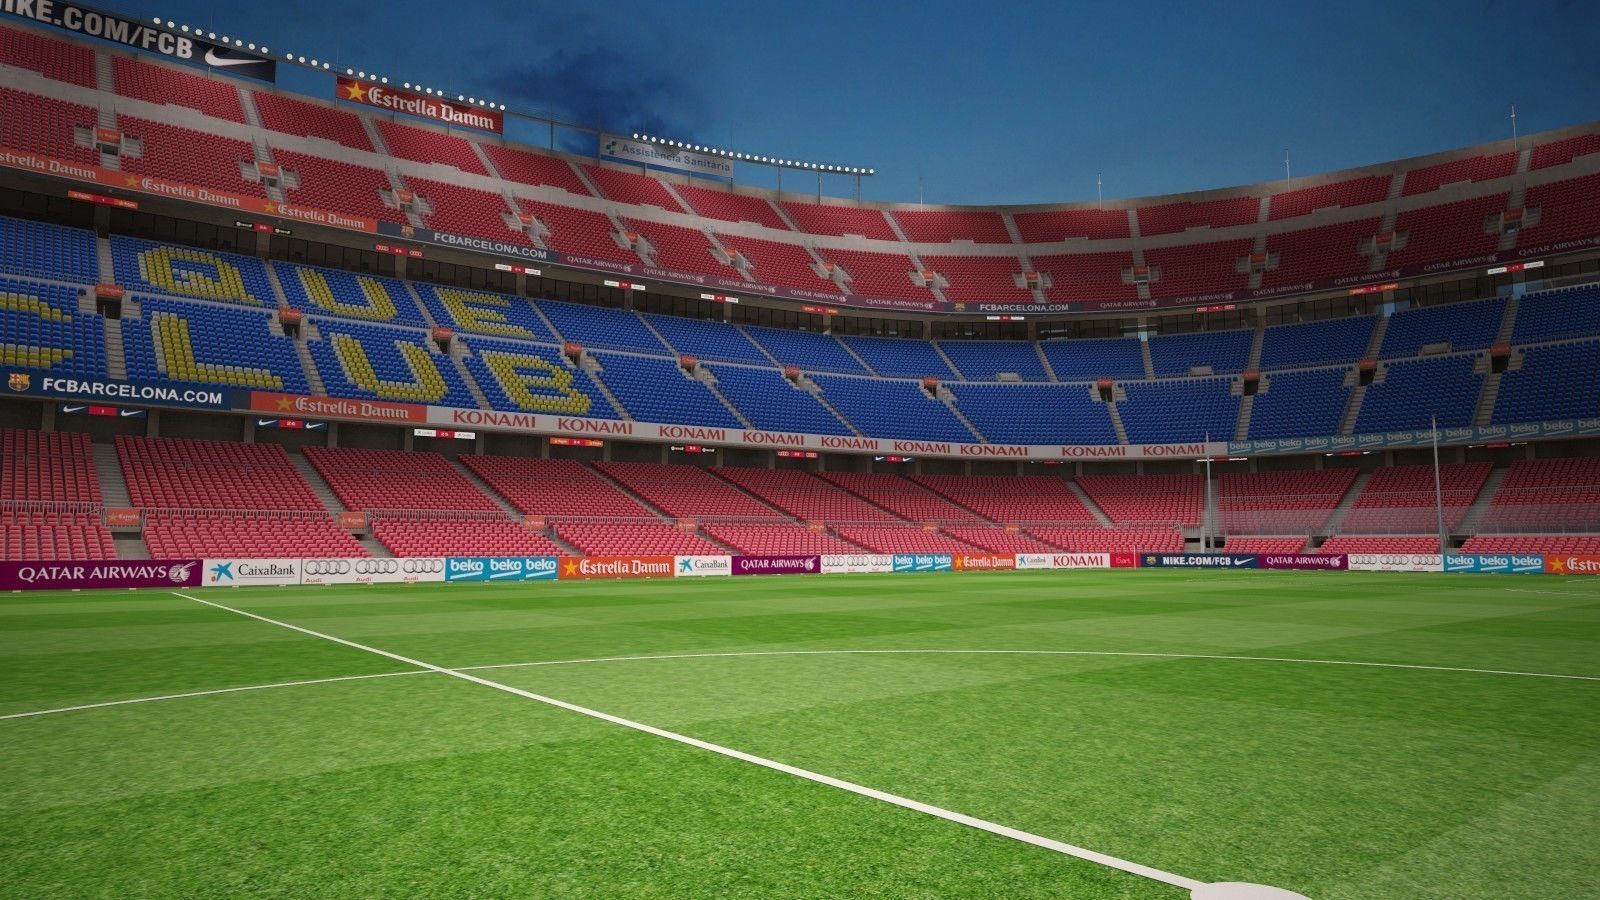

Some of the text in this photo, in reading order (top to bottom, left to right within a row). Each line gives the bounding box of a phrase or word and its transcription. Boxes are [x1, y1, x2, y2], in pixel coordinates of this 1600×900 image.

[0, 0, 193, 59] IKE.COM/FCB
[368, 86, 494, 130] Estrella Damm
[48, 159, 96, 180] Damm
[141, 177, 240, 207] Estrella Damm
[278, 204, 365, 229] Estrella Damm
[434, 232, 547, 260] FCBARCELONA.COM
[1519, 245, 1550, 257] QATAR
[567, 255, 592, 265] QATAR
[1424, 261, 1450, 272] QATAR
[644, 268, 666, 277] QATAR
[718, 279, 740, 288] QATAR
[1334, 276, 1358, 285] QATAR
[790, 289, 812, 297] QATAR
[1252, 287, 1275, 297] QATAR
[866, 298, 892, 306] QATAR
[1176, 296, 1196, 304] QATAR
[980, 304, 1069, 312] FCBARCELONA.COM
[42, 378, 223, 405] FCBARCELONA.COM
[295, 398, 408, 419] Estrella Damm
[454, 410, 536, 428] KONAMI
[558, 418, 633, 435] KONAMI
[1478, 425, 1506, 435] beko
[1510, 423, 1539, 433] beko
[1543, 421, 1574, 431] beko
[659, 425, 726, 441] KONAMI
[1386, 432, 1412, 441] beko
[1446, 428, 1472, 438] beko
[743, 431, 804, 446] KONAMI
[821, 437, 878, 450] KONAMI
[1280, 438, 1302, 448] beko
[1304, 438, 1328, 446] beko
[1332, 436, 1356, 445] beko
[1358, 434, 1384, 443] beko
[894, 442, 951, 454] KONAMI
[1230, 442, 1250, 450] beko
[1254, 440, 1276, 449] beko
[960, 444, 1028, 456] KONAMI
[1062, 446, 1126, 457] KONAMI
[1143, 444, 1205, 456] KONAMI
[490, 558, 522, 570] beko
[526, 558, 556, 570] beko
[694, 559, 728, 569] CaixaBank
[740, 559, 804, 570] QATAR AIRWAYS
[895, 556, 913, 565] beko
[916, 555, 933, 564] beko
[935, 555, 952, 564] beko
[963, 556, 1014, 568] Estrella Damm
[1053, 556, 1104, 566] KONAMI
[1162, 556, 1231, 566] NIKE.COM/FCB
[1266, 556, 1330, 566] QATAR AIRWAYS
[1446, 556, 1474, 566] beko
[1480, 556, 1508, 566] beko
[1512, 556, 1542, 566] beko
[238, 564, 295, 576] CaixaBank
[450, 559, 484, 572] beko
[579, 559, 670, 575] Estrella Damm
[18, 566, 167, 582] QATAR AIRWAYS
